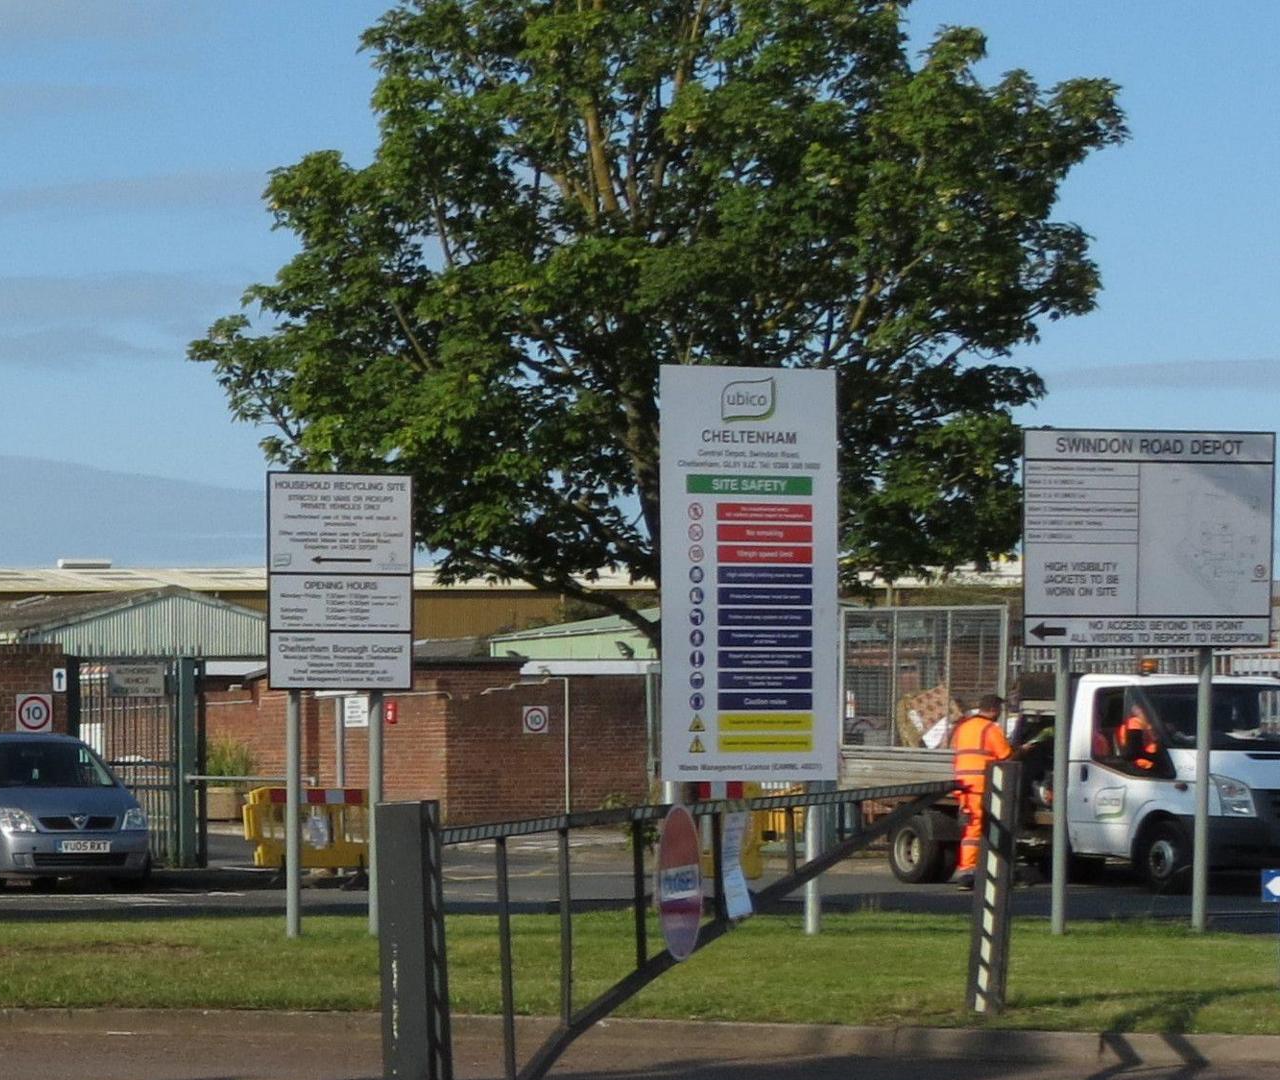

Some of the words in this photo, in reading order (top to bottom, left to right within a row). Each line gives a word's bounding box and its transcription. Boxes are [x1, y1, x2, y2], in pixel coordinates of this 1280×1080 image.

[726, 391, 768, 407] ubico
[702, 429, 797, 445] CHELTENHAM
[1056, 438, 1133, 454] SWINDON
[1139, 439, 1184, 455] ROAD
[1191, 440, 1244, 455] DEPOT
[275, 480, 330, 490] HOUSEHOLD
[333, 482, 384, 491] RECYCLING
[387, 482, 407, 491] SITE
[712, 479, 738, 491] SITE
[741, 479, 787, 492] SAFETY
[1044, 561, 1068, 571] HIGH
[1071, 562, 1119, 571] VISIBILITY
[1044, 574, 1088, 584] JACKETS
[1091, 575, 1104, 584] TO
[304, 581, 344, 590] OPENING
[346, 581, 378, 590] HOURS
[1045, 586, 1076, 596] WORN
[1079, 587, 1094, 596] ON
[1096, 587, 1118, 596] SITE
[1088, 621, 1104, 630] NO
[1107, 621, 1148, 630] ACCESS
[1150, 621, 1189, 630] BEYOND
[1191, 621, 1213, 630] THIS
[1216, 621, 1244, 630] POINT
[1091, 633, 1135, 642] VISITORS
[1138, 633, 1150, 642] TO
[1153, 633, 1191, 642] REPORT
[1194, 633, 1207, 642] TO
[1210, 633, 1264, 643] RECEPTION
[279, 644, 329, 653] Cheltenham
[333, 645, 369, 654] Borough
[372, 645, 403, 654] Council
[24, 706, 42, 721] 10
[529, 714, 542, 726] 10
